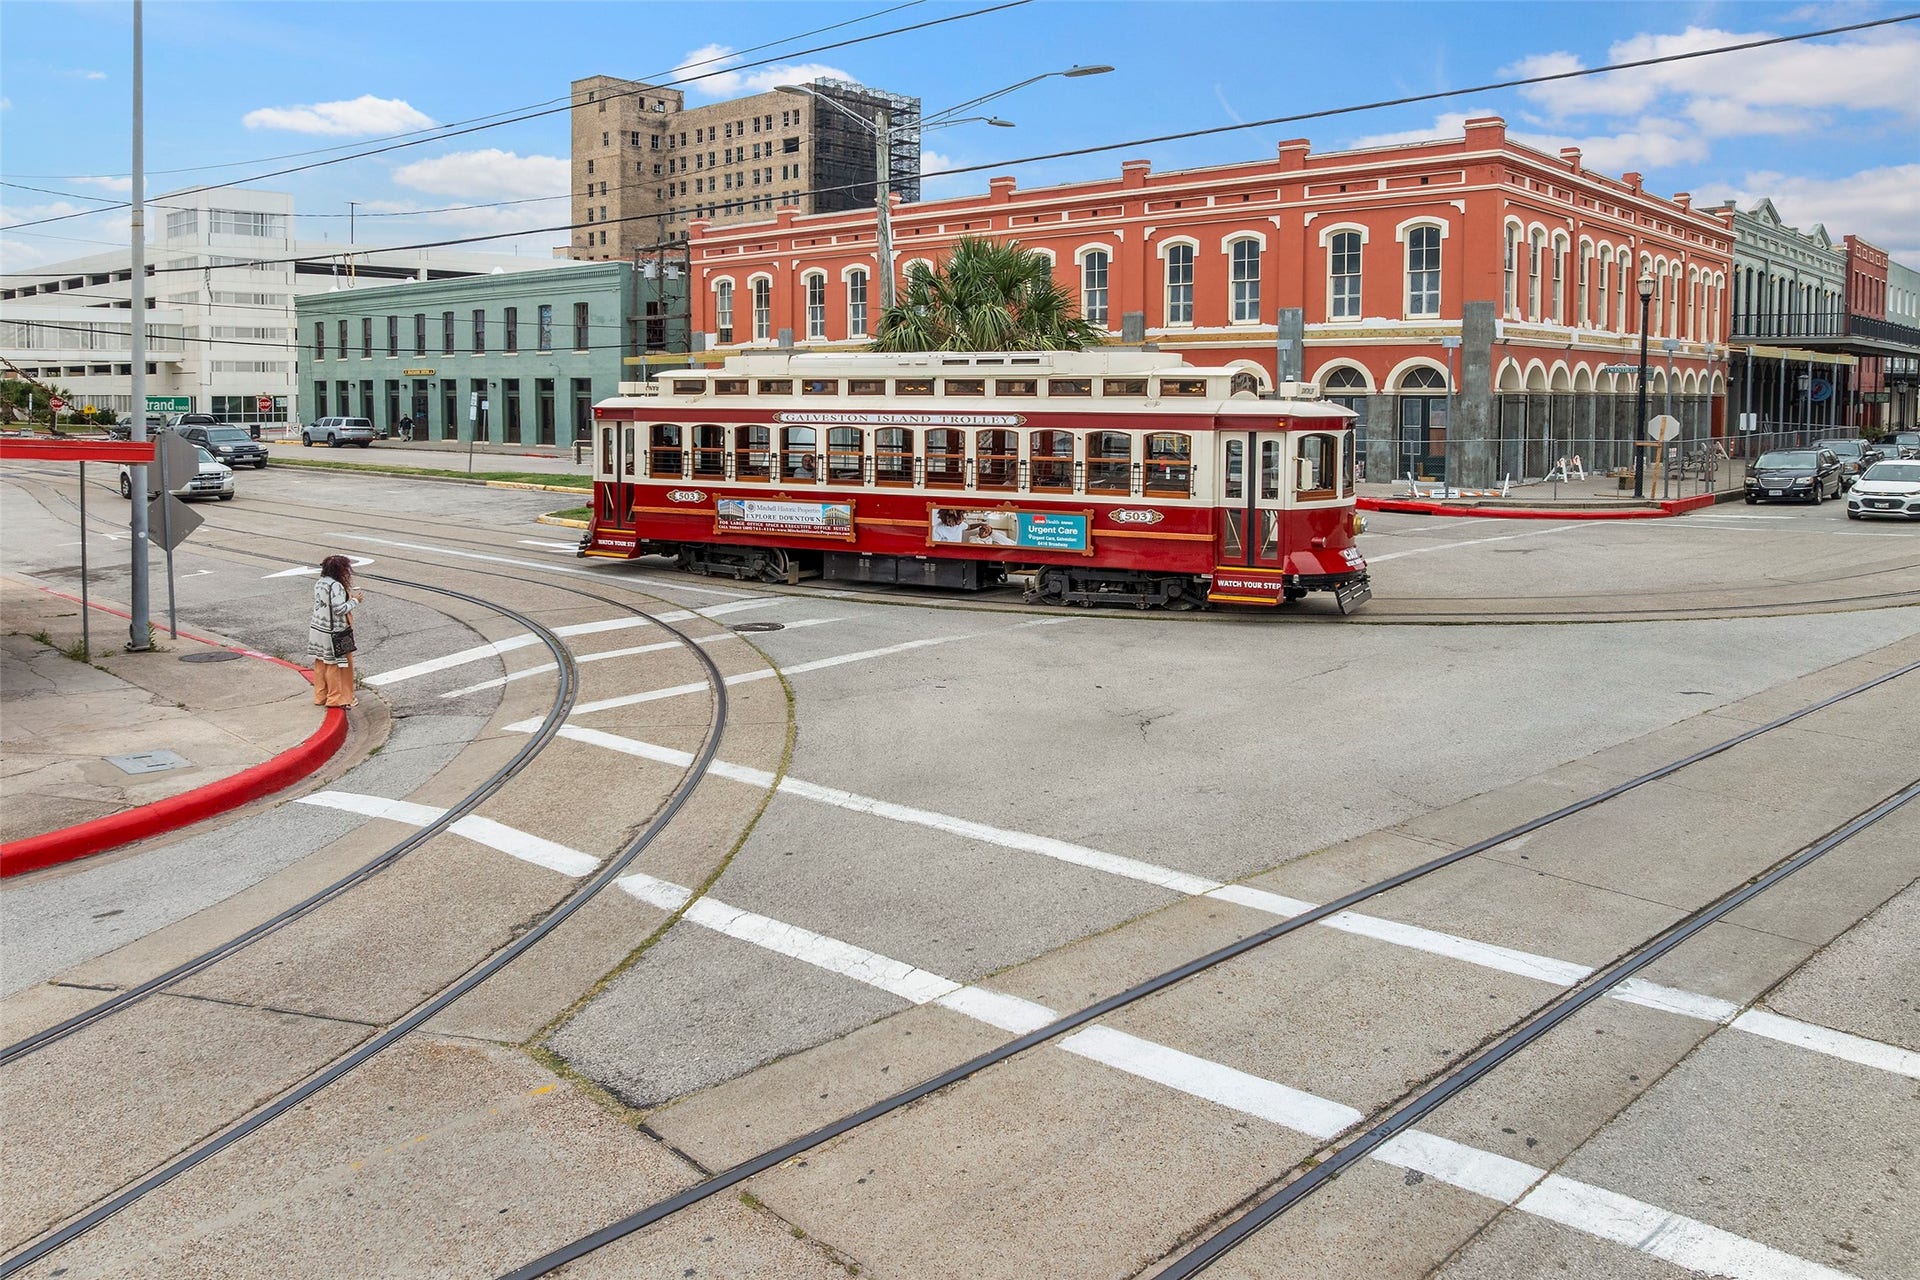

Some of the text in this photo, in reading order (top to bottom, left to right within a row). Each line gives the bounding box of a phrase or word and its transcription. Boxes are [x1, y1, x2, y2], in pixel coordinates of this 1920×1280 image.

[145, 399, 175, 411] trand
[785, 414, 1010, 424] GALVESTON ISLAND TROLLEY
[678, 492, 695, 500] 503
[779, 514, 820, 522] DOWNTOWN
[1125, 512, 1147, 520] 503
[1028, 525, 1078, 535] Urgent Care
[1217, 579, 1282, 590] WATCH YOUR STEP
